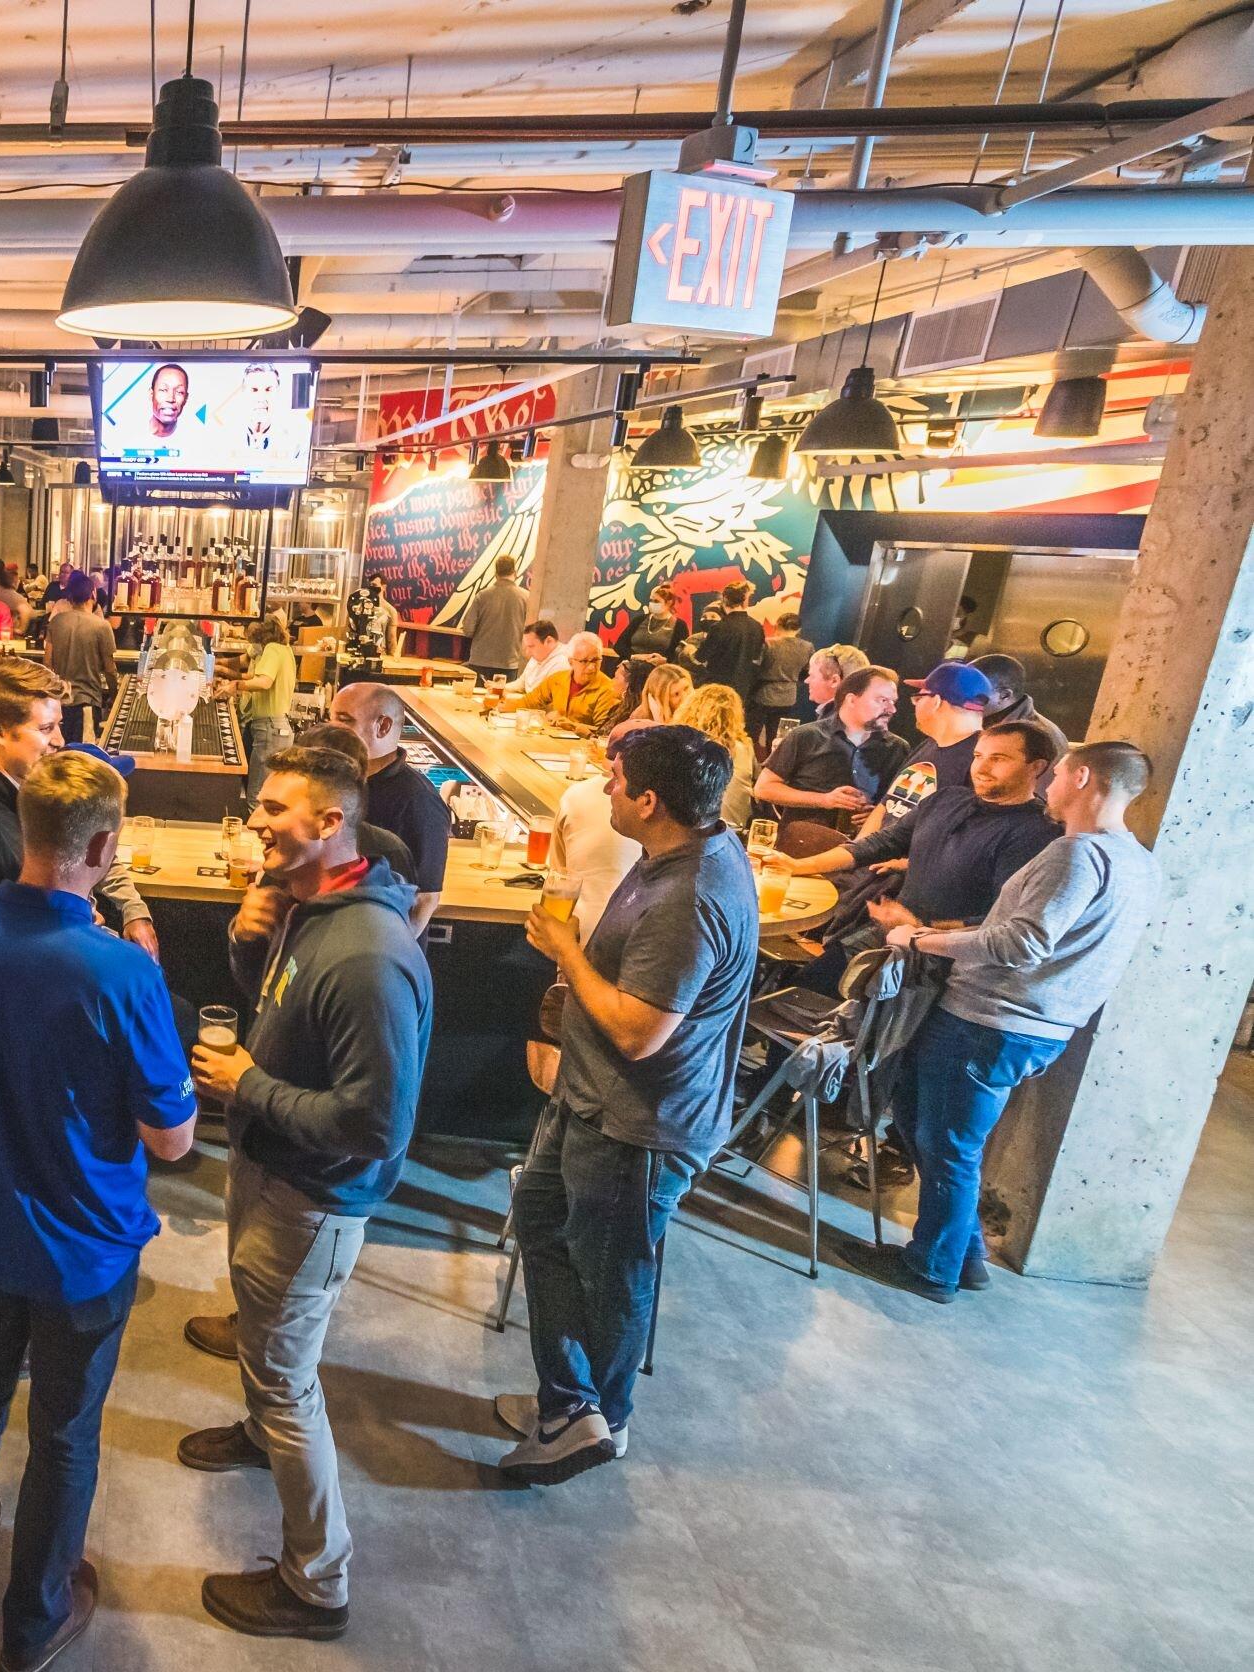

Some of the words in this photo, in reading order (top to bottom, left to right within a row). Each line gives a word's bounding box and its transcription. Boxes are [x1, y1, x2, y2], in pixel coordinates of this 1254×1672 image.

[668, 188, 774, 310] EXIT
[410, 492, 444, 513] more
[394, 517, 438, 537] insure
[440, 503, 504, 530] domestic
[401, 530, 454, 561] promote
[457, 526, 479, 551] the
[407, 557, 427, 578] the
[391, 584, 413, 601] our
